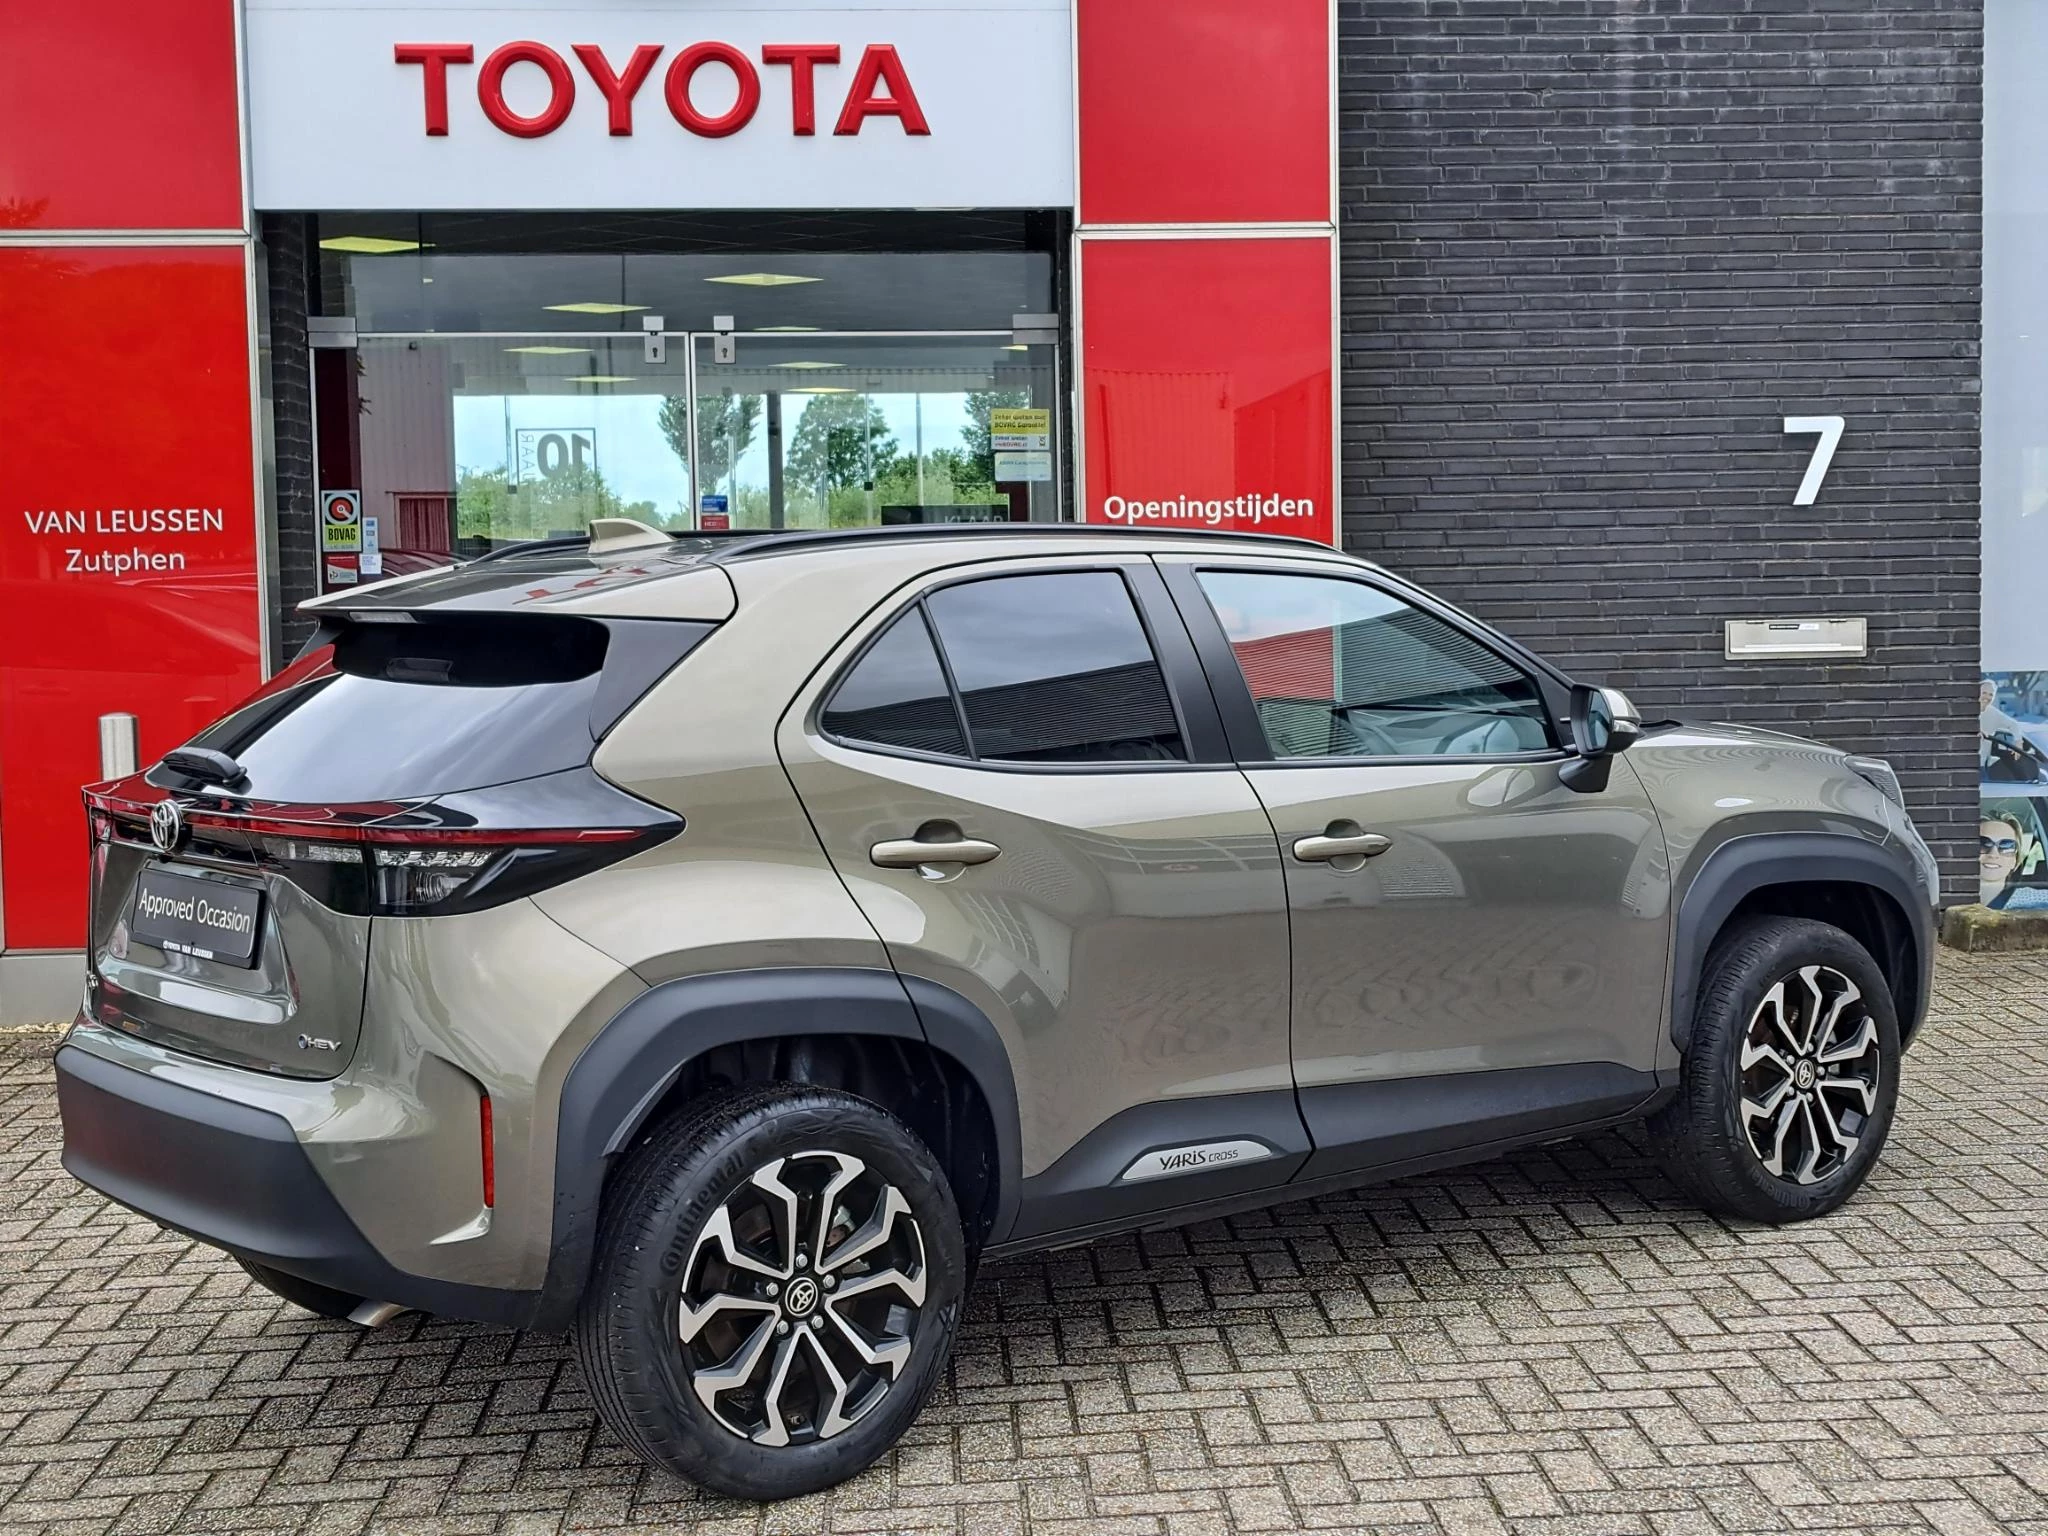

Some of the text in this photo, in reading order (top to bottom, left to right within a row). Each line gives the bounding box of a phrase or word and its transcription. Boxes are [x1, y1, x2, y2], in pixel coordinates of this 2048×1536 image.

[394, 41, 932, 138] TOYOTA
[1783, 415, 1845, 505] 7
[24, 508, 224, 534] VAN LEUSSEN
[1104, 493, 1314, 525] Openingstijden
[328, 527, 356, 541] BOVAG
[65, 547, 186, 576] Zutphen
[139, 888, 251, 933] Approved Occasion
[307, 1036, 342, 1051] HEV
[1208, 1149, 1239, 1163] CROSS
[660, 1150, 744, 1276] Continental
